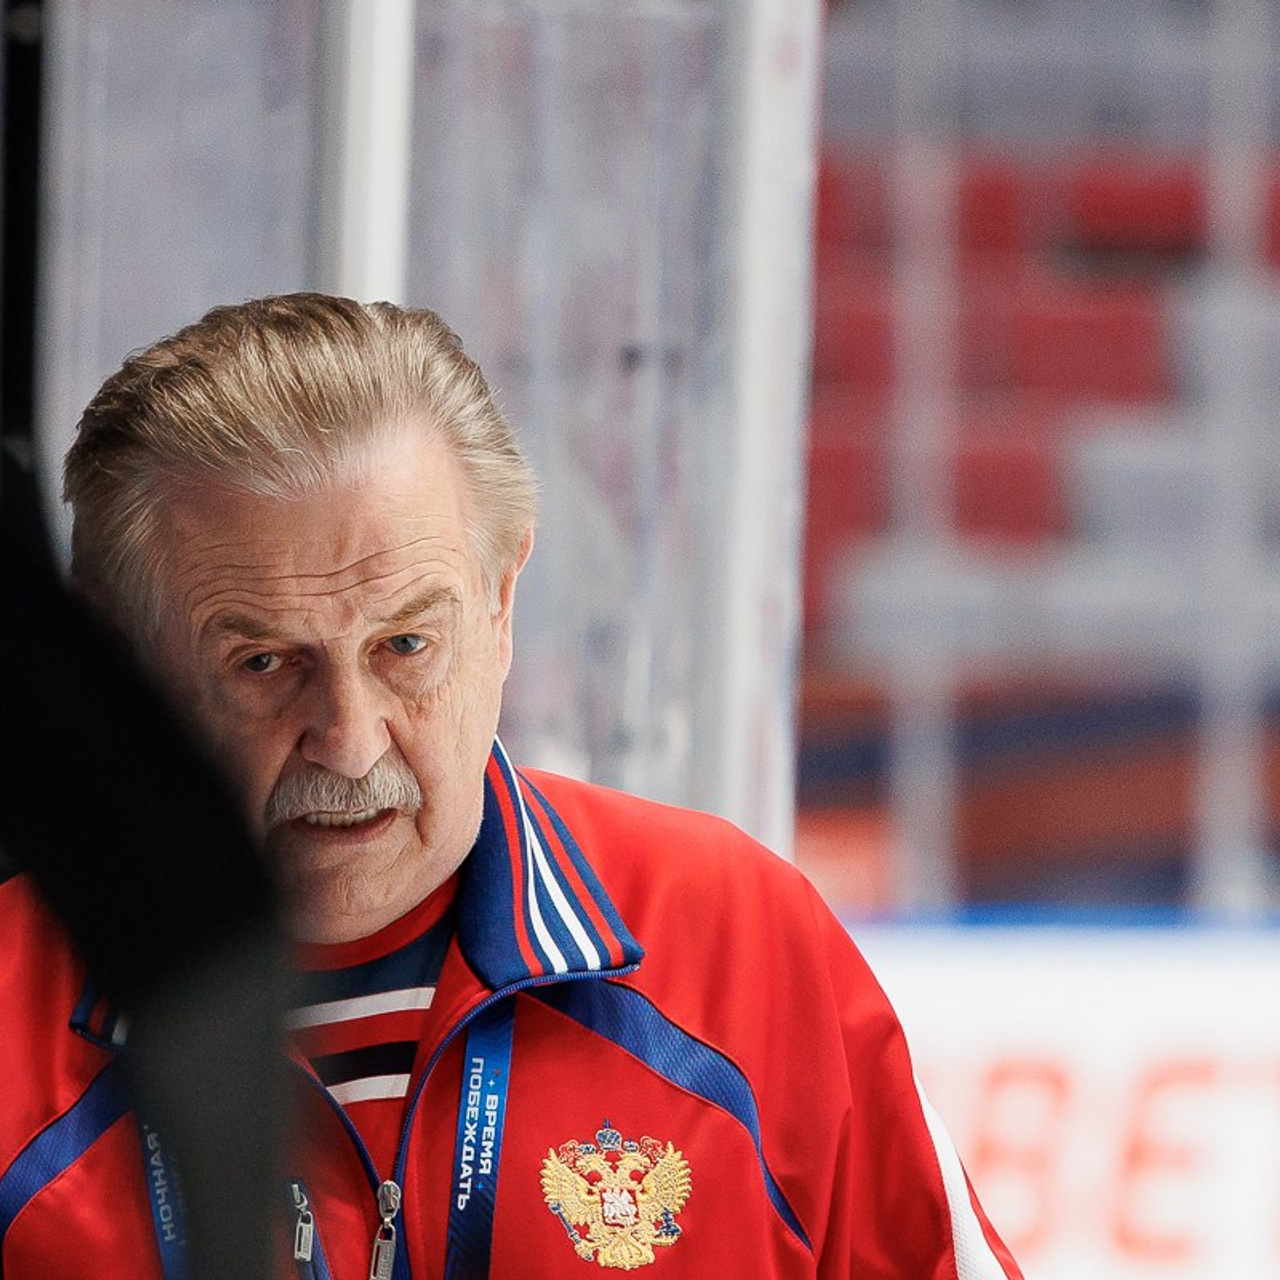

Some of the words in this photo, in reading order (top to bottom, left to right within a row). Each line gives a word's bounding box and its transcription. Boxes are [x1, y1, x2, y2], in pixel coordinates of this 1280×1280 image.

[147, 1132, 175, 1241] НОЧНАЯ
[457, 1057, 484, 1211] ПОБЕЖДАТЬ
[478, 1094, 499, 1174] ВРЕМЯ
